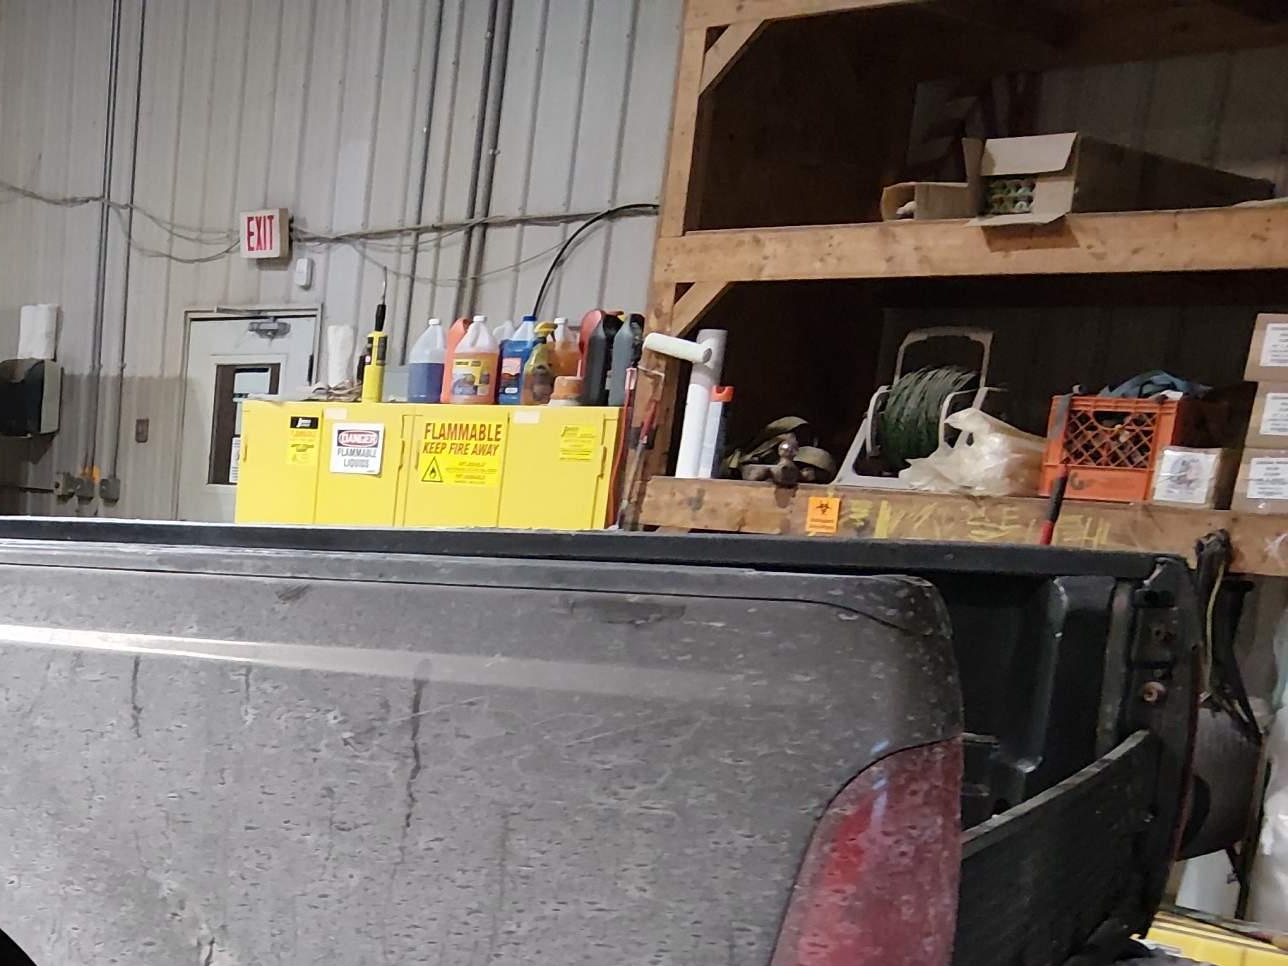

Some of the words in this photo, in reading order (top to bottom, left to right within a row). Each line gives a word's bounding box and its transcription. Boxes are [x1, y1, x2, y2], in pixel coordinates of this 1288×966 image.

[247, 215, 274, 251] EXIT
[342, 432, 377, 444] DANGER
[424, 423, 503, 441] FLAMMABLE
[337, 447, 377, 458] FLAMMABLE
[422, 442, 448, 454] KEEP
[448, 442, 471, 455] FIRE
[471, 443, 500, 456] AWAY
